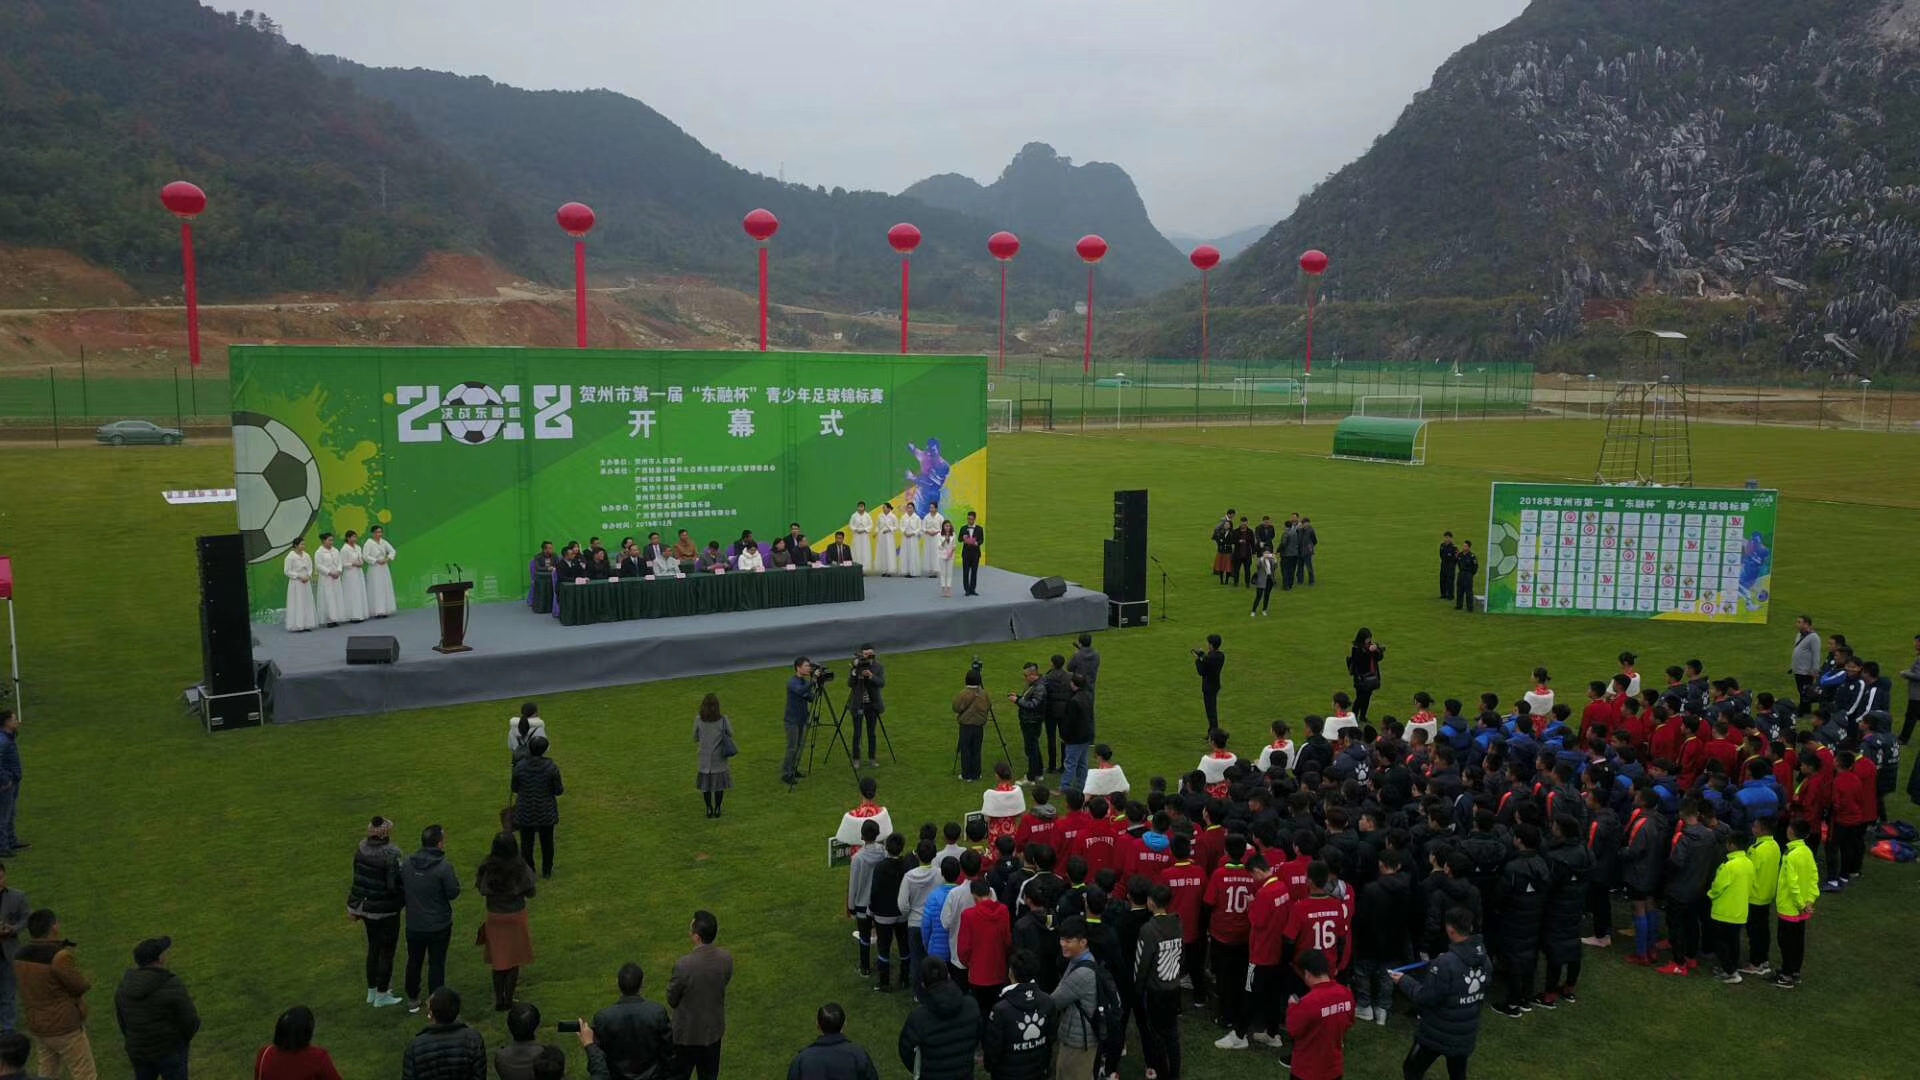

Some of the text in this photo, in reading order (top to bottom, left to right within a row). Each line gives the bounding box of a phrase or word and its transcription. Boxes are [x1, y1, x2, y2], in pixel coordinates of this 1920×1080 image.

[396, 382, 573, 444] 2018
[1225, 885, 1249, 913] 10
[1312, 920, 1336, 950] 16
